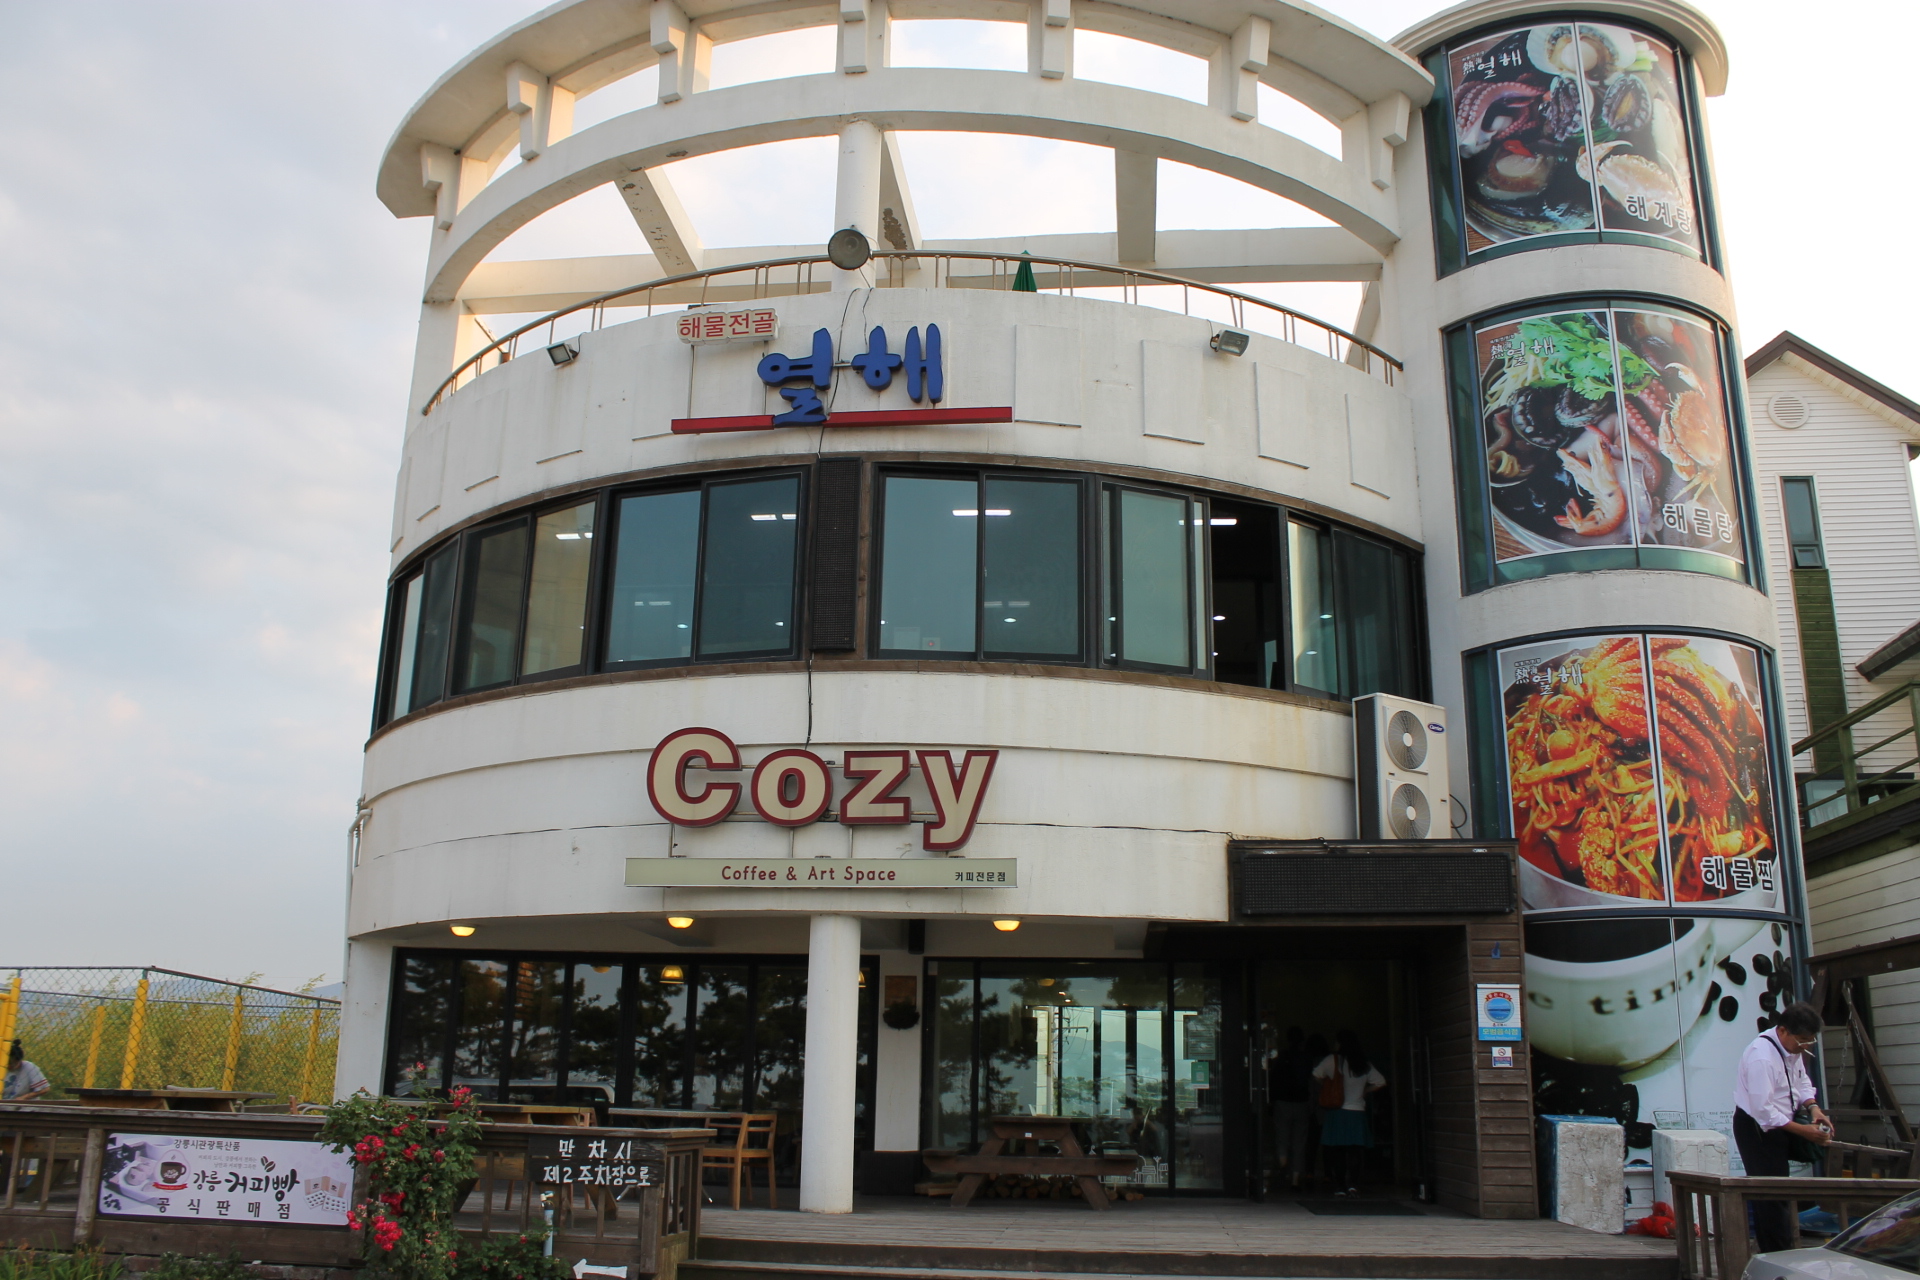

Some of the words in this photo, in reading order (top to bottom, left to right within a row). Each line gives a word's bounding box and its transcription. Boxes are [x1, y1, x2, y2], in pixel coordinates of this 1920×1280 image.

[1625, 194, 1693, 235] 해계탕
[678, 309, 776, 339] 해물전골
[757, 323, 943, 427] 열해
[1662, 503, 1734, 543] 해물탕
[647, 726, 999, 852] Cozy
[721, 865, 777, 882] Coffee
[786, 866, 798, 881] &
[807, 865, 836, 881] Art
[843, 865, 896, 885] Space
[954, 871, 1007, 883] 커피전문점
[1701, 856, 1775, 892] 해물찜
[193, 1170, 222, 1193] 강릉
[224, 1169, 300, 1202] 커피빵
